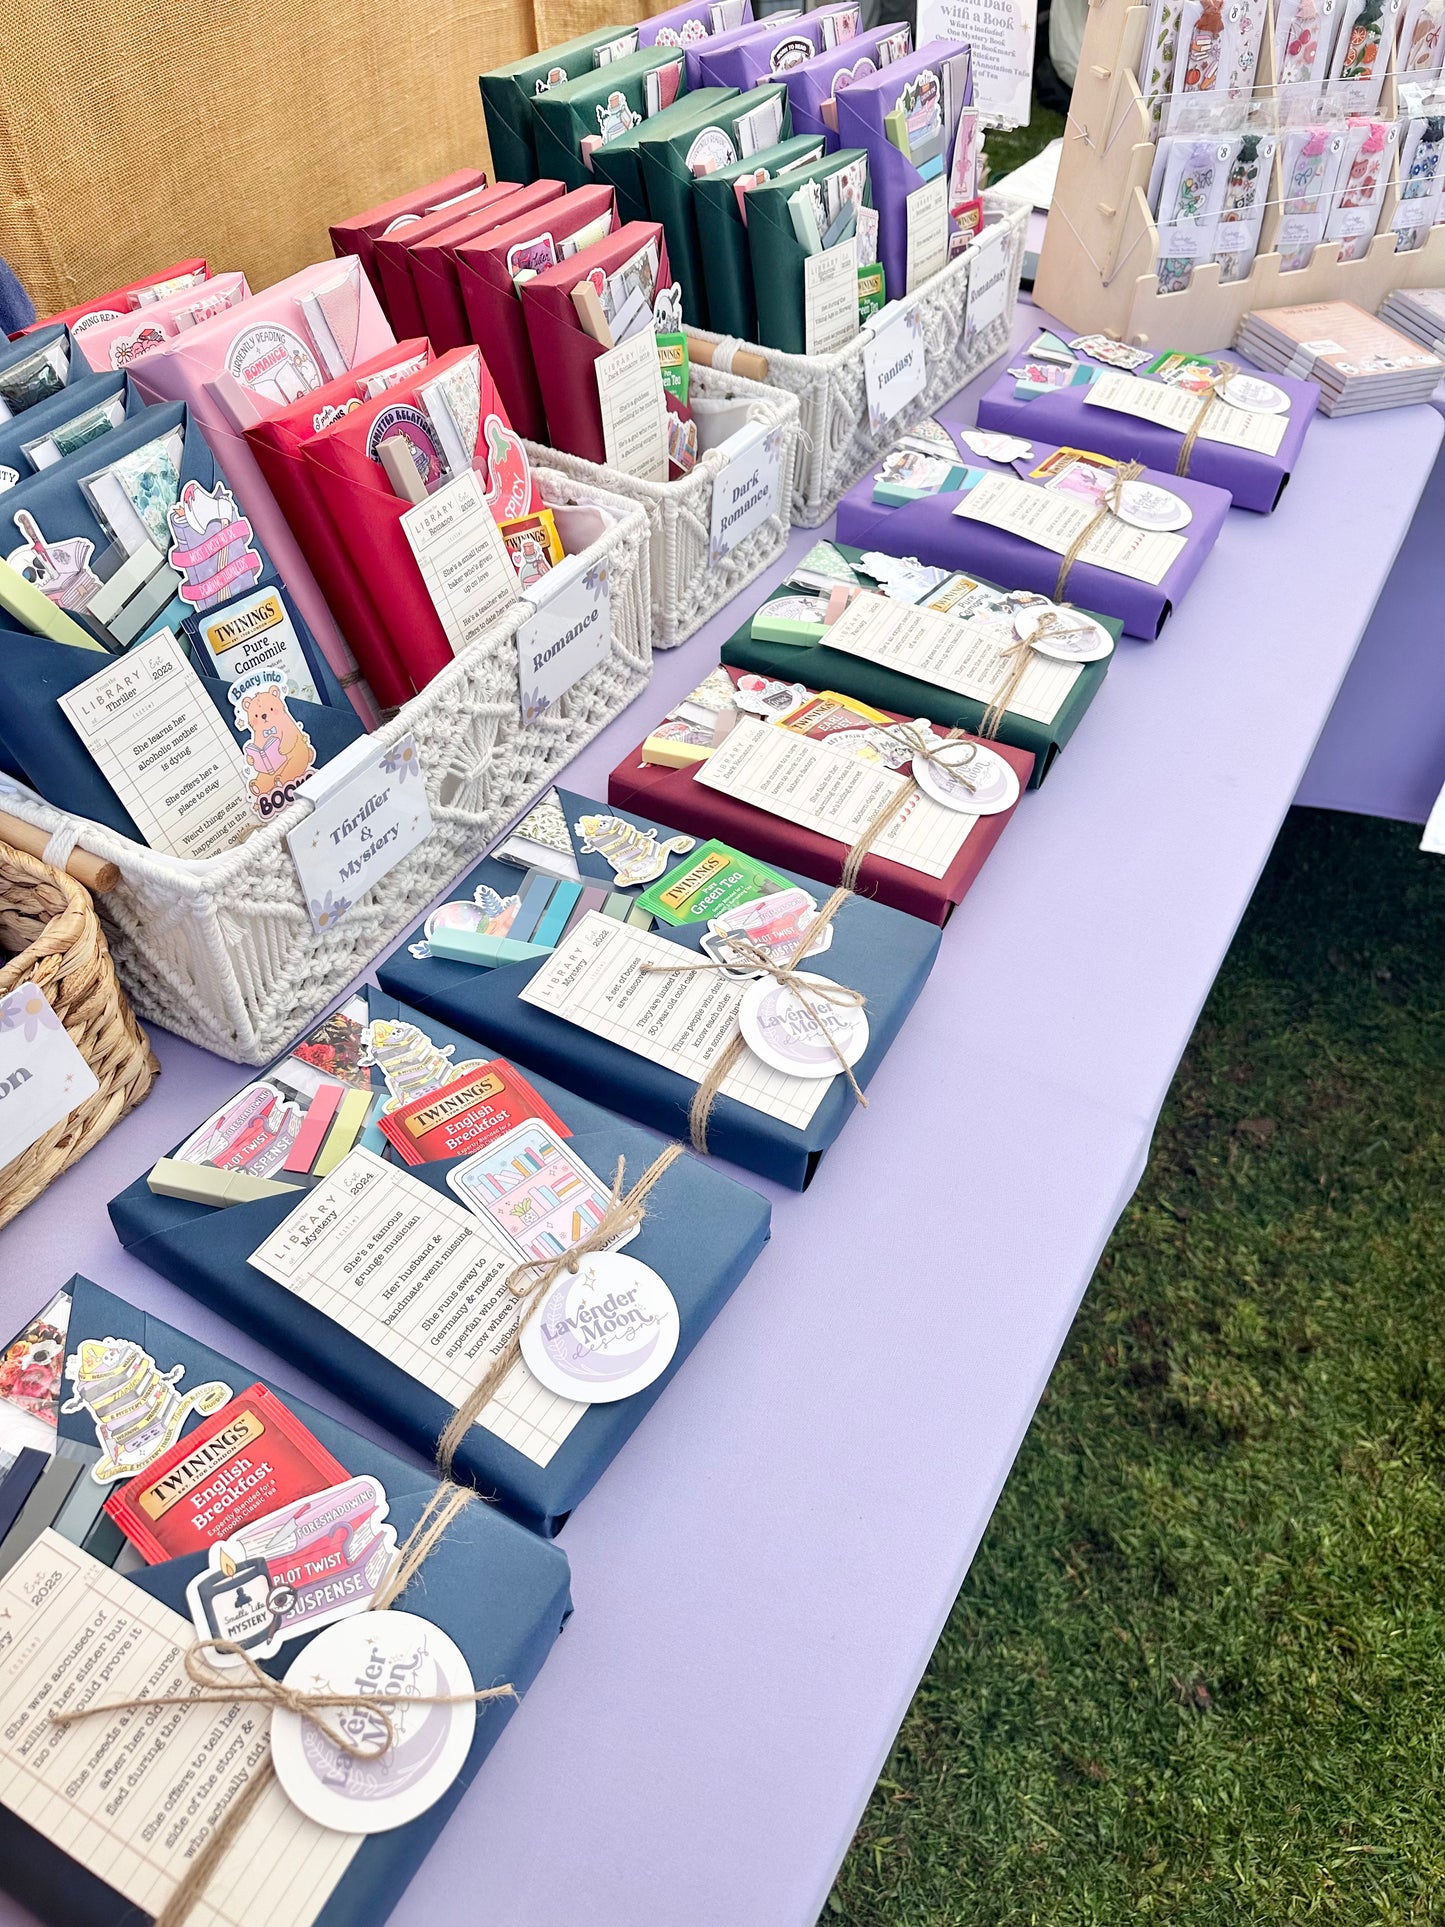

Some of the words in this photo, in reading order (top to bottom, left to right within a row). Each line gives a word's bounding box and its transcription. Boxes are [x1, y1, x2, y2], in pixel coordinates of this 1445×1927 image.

[982, 13, 1015, 30] Book
[232, 337, 255, 378] CURRENTLY
[255, 331, 286, 344] READING
[244, 345, 287, 381] ROMANCE
[876, 351, 914, 389] Fantasy
[505, 473, 524, 519] SPICY
[719, 483, 769, 533] Romance
[731, 471, 759, 503] Dark
[412, 502, 455, 533] LIBRARY
[427, 515, 455, 535] Romance
[188, 546, 205, 562] MOST
[441, 563, 458, 576] She's
[460, 550, 476, 563] small
[474, 541, 489, 553] town
[929, 580, 972, 609] TWININGS
[957, 594, 976, 608] Pure
[213, 603, 277, 642] TWININGS
[532, 607, 600, 674] Romance
[232, 640, 288, 674] Camomile
[242, 637, 270, 656] Pure
[80, 670, 142, 714] LIBRARY
[104, 686, 139, 712] Thriller
[151, 661, 174, 680] 2023
[230, 674, 263, 700] Beary
[262, 667, 281, 686] into
[131, 740, 150, 755] She
[148, 724, 174, 743] learns
[171, 713, 187, 726] her
[792, 699, 834, 732] TWININGS
[818, 711, 843, 732] EARL
[830, 717, 851, 735] REY
[136, 743, 173, 770] alcoholic
[169, 723, 199, 745] mother
[167, 746, 192, 766] dying
[712, 741, 746, 777] LIBRARY
[176, 796, 198, 815] place
[203, 779, 221, 794] stay
[329, 788, 392, 843] Thriller
[338, 824, 400, 882] Mystery
[357, 825, 373, 841] &
[663, 856, 722, 901] TWININGS
[688, 885, 727, 916] Green
[720, 870, 744, 890] Tea
[702, 882, 717, 893] Pure
[772, 925, 795, 939] TWIST
[541, 947, 584, 995] LIBRARY
[561, 957, 587, 987] Mystery
[592, 928, 609, 947] 2022
[654, 1009, 670, 1026] year
[673, 982, 688, 998] cold
[684, 968, 697, 983] case
[691, 1027, 709, 1047] know
[704, 1011, 720, 1028] each
[715, 993, 732, 1012] other
[224, 1087, 269, 1141] FORESHADOWING
[414, 1076, 492, 1128] TWININGS
[446, 1102, 494, 1136] English
[223, 1151, 243, 1172] PLOT
[242, 1128, 268, 1157] TWIST
[445, 1107, 510, 1150] Breakfast
[249, 1131, 292, 1180] USPENSE
[273, 1194, 338, 1260] LIBRARY
[299, 1209, 338, 1249] Mystery
[350, 1171, 374, 1195] 2024
[342, 1246, 368, 1273] She's
[371, 1209, 403, 1242] famous
[353, 1252, 385, 1285] grunge
[381, 1213, 420, 1253] musician
[380, 1280, 425, 1326] bandmate
[420, 1258, 443, 1282] went
[439, 1226, 472, 1260] missing
[381, 1280, 401, 1300] Her
[397, 1242, 435, 1281] husband
[539, 1286, 641, 1341] Lavender
[570, 1312, 671, 1360] designs
[579, 1302, 652, 1343] Moon
[148, 1421, 252, 1502] TWININGS
[189, 1456, 254, 1510] English
[191, 1461, 275, 1529] Breakfast
[215, 1514, 244, 1537] Smooth
[241, 1496, 266, 1516] Classic
[263, 1486, 277, 1498] Tea
[292, 1488, 379, 1538] FORESHADOWING
[30, 1570, 62, 1605] 2023
[272, 1566, 303, 1587] PLOT
[303, 1552, 343, 1576] TWIST
[223, 1608, 249, 1623] Smells
[226, 1612, 269, 1636] MYSTERY
[2, 1709, 31, 1740] She
[26, 1681, 53, 1710] was
[48, 1627, 96, 1681] accused
[91, 1609, 108, 1627] of
[16, 1708, 59, 1756] killing
[52, 1680, 78, 1708] her
[73, 1646, 105, 1682] sister
[99, 1616, 128, 1647] but
[140, 1811, 167, 1841] She
[159, 1769, 198, 1812] offers
[191, 1751, 208, 1769] to
[201, 1728, 223, 1751] tell
[217, 1701, 243, 1729] her
[161, 1815, 191, 1848] side
[183, 1795, 203, 1816] of
[194, 1771, 219, 1798] the
[212, 1737, 247, 1775] story
[239, 1718, 255, 1734] &
